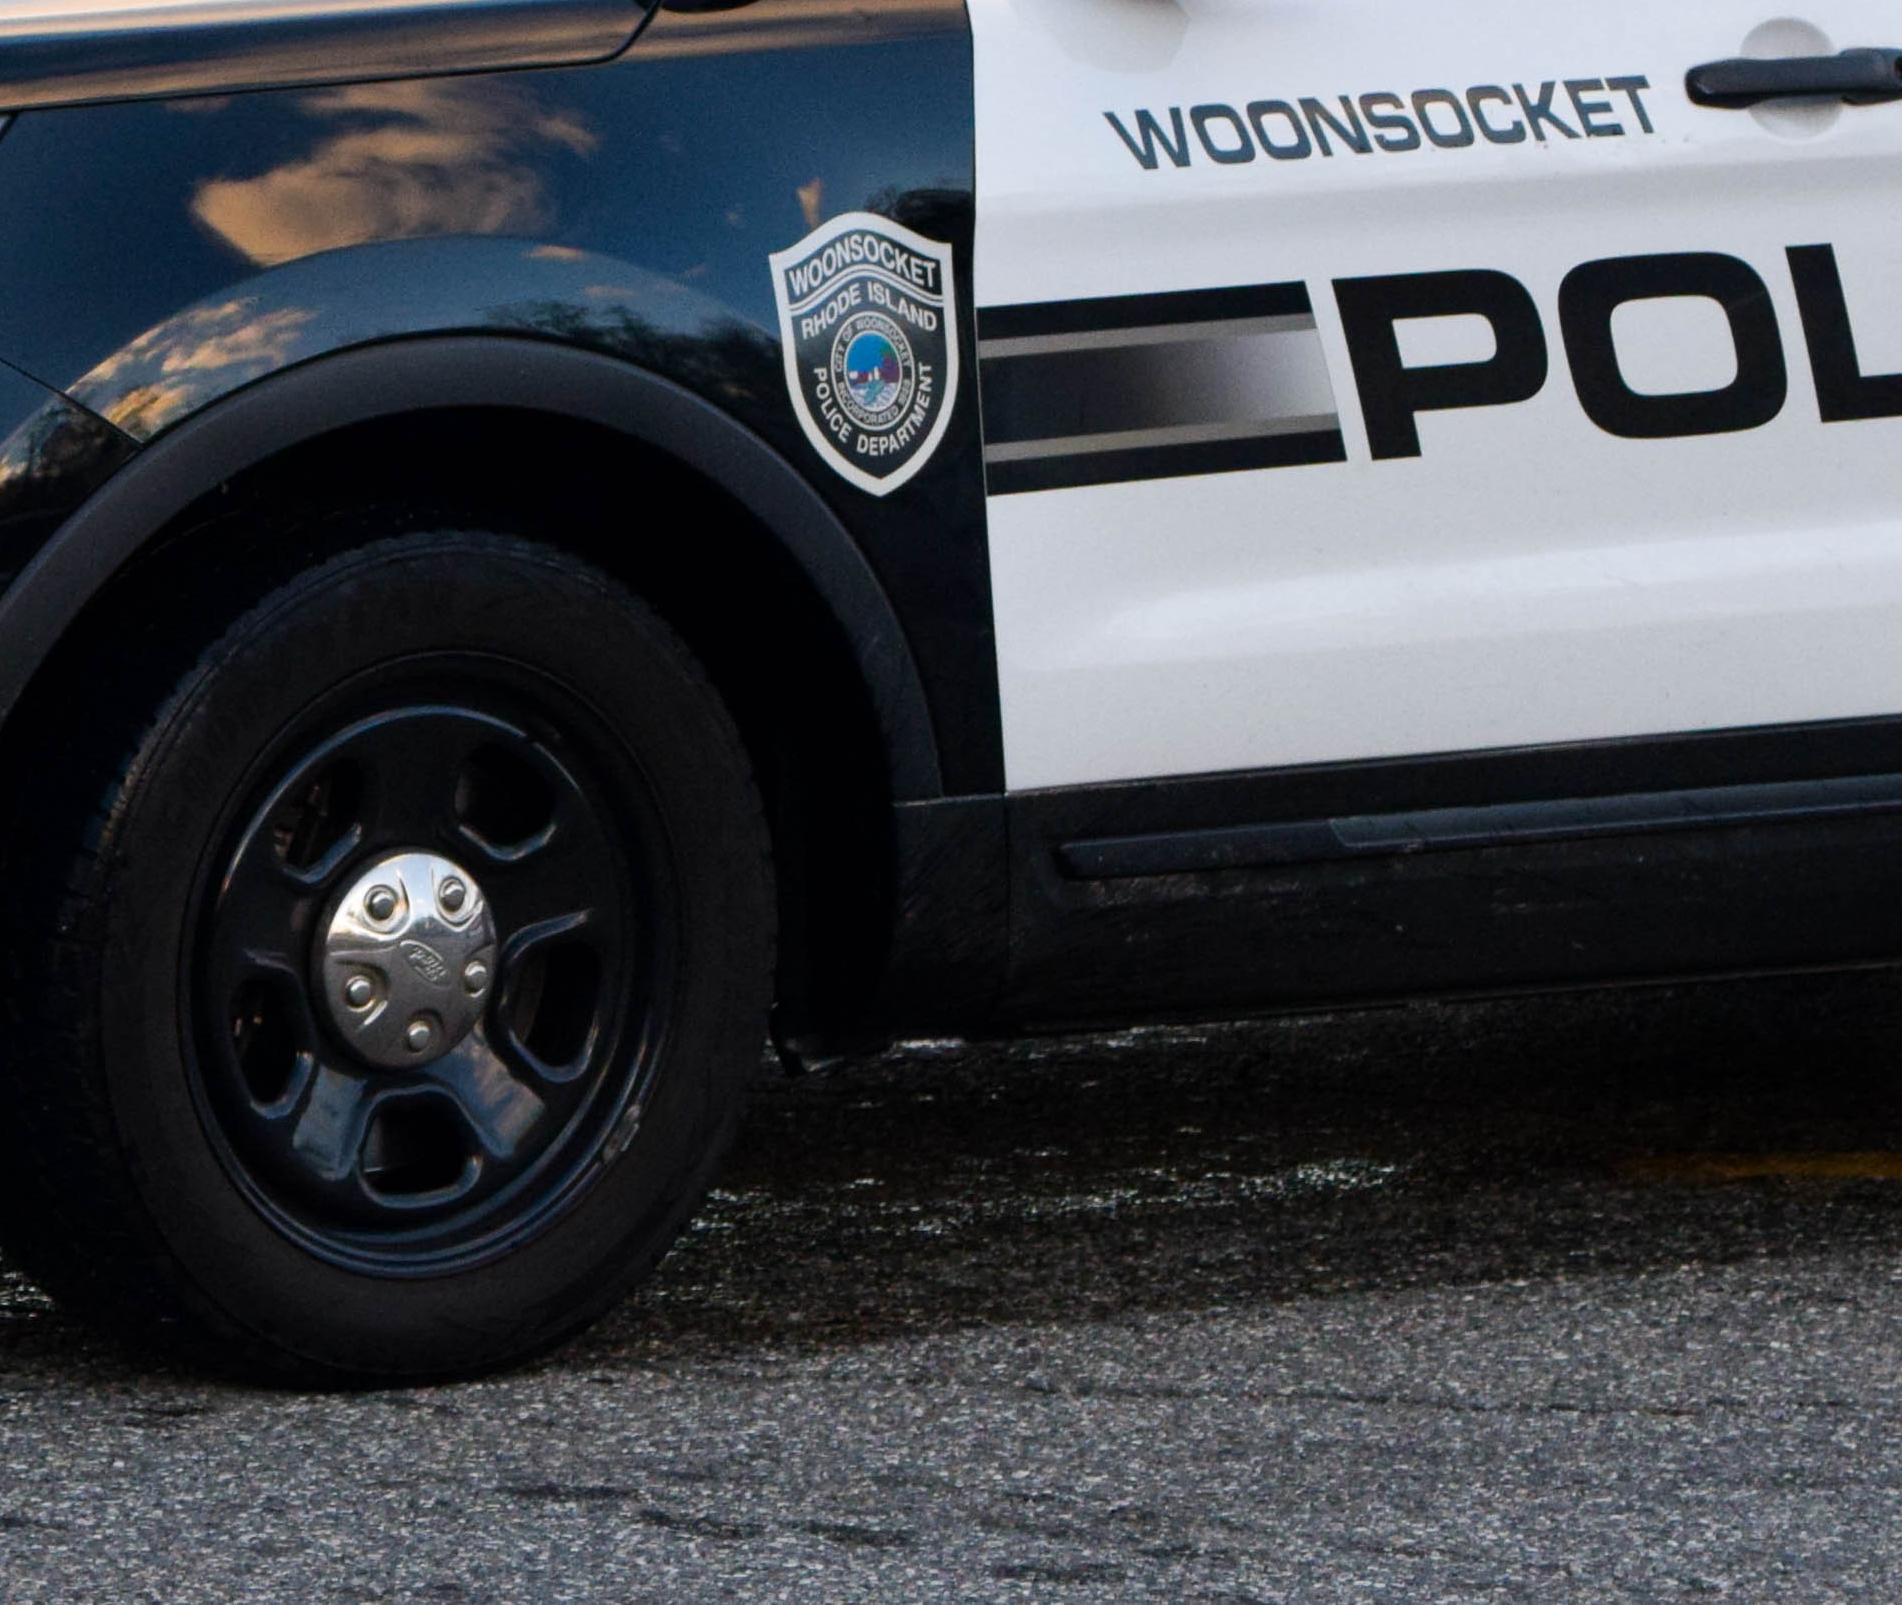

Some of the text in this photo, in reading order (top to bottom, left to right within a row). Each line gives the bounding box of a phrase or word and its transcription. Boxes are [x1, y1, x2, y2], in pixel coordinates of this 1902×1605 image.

[1102, 75, 1655, 170] WOONSOCKET
[788, 233, 938, 297] WOONSOCKET
[800, 281, 938, 340] RHODE ISLAND
[813, 361, 934, 456] POLICE DEPARTMENT
